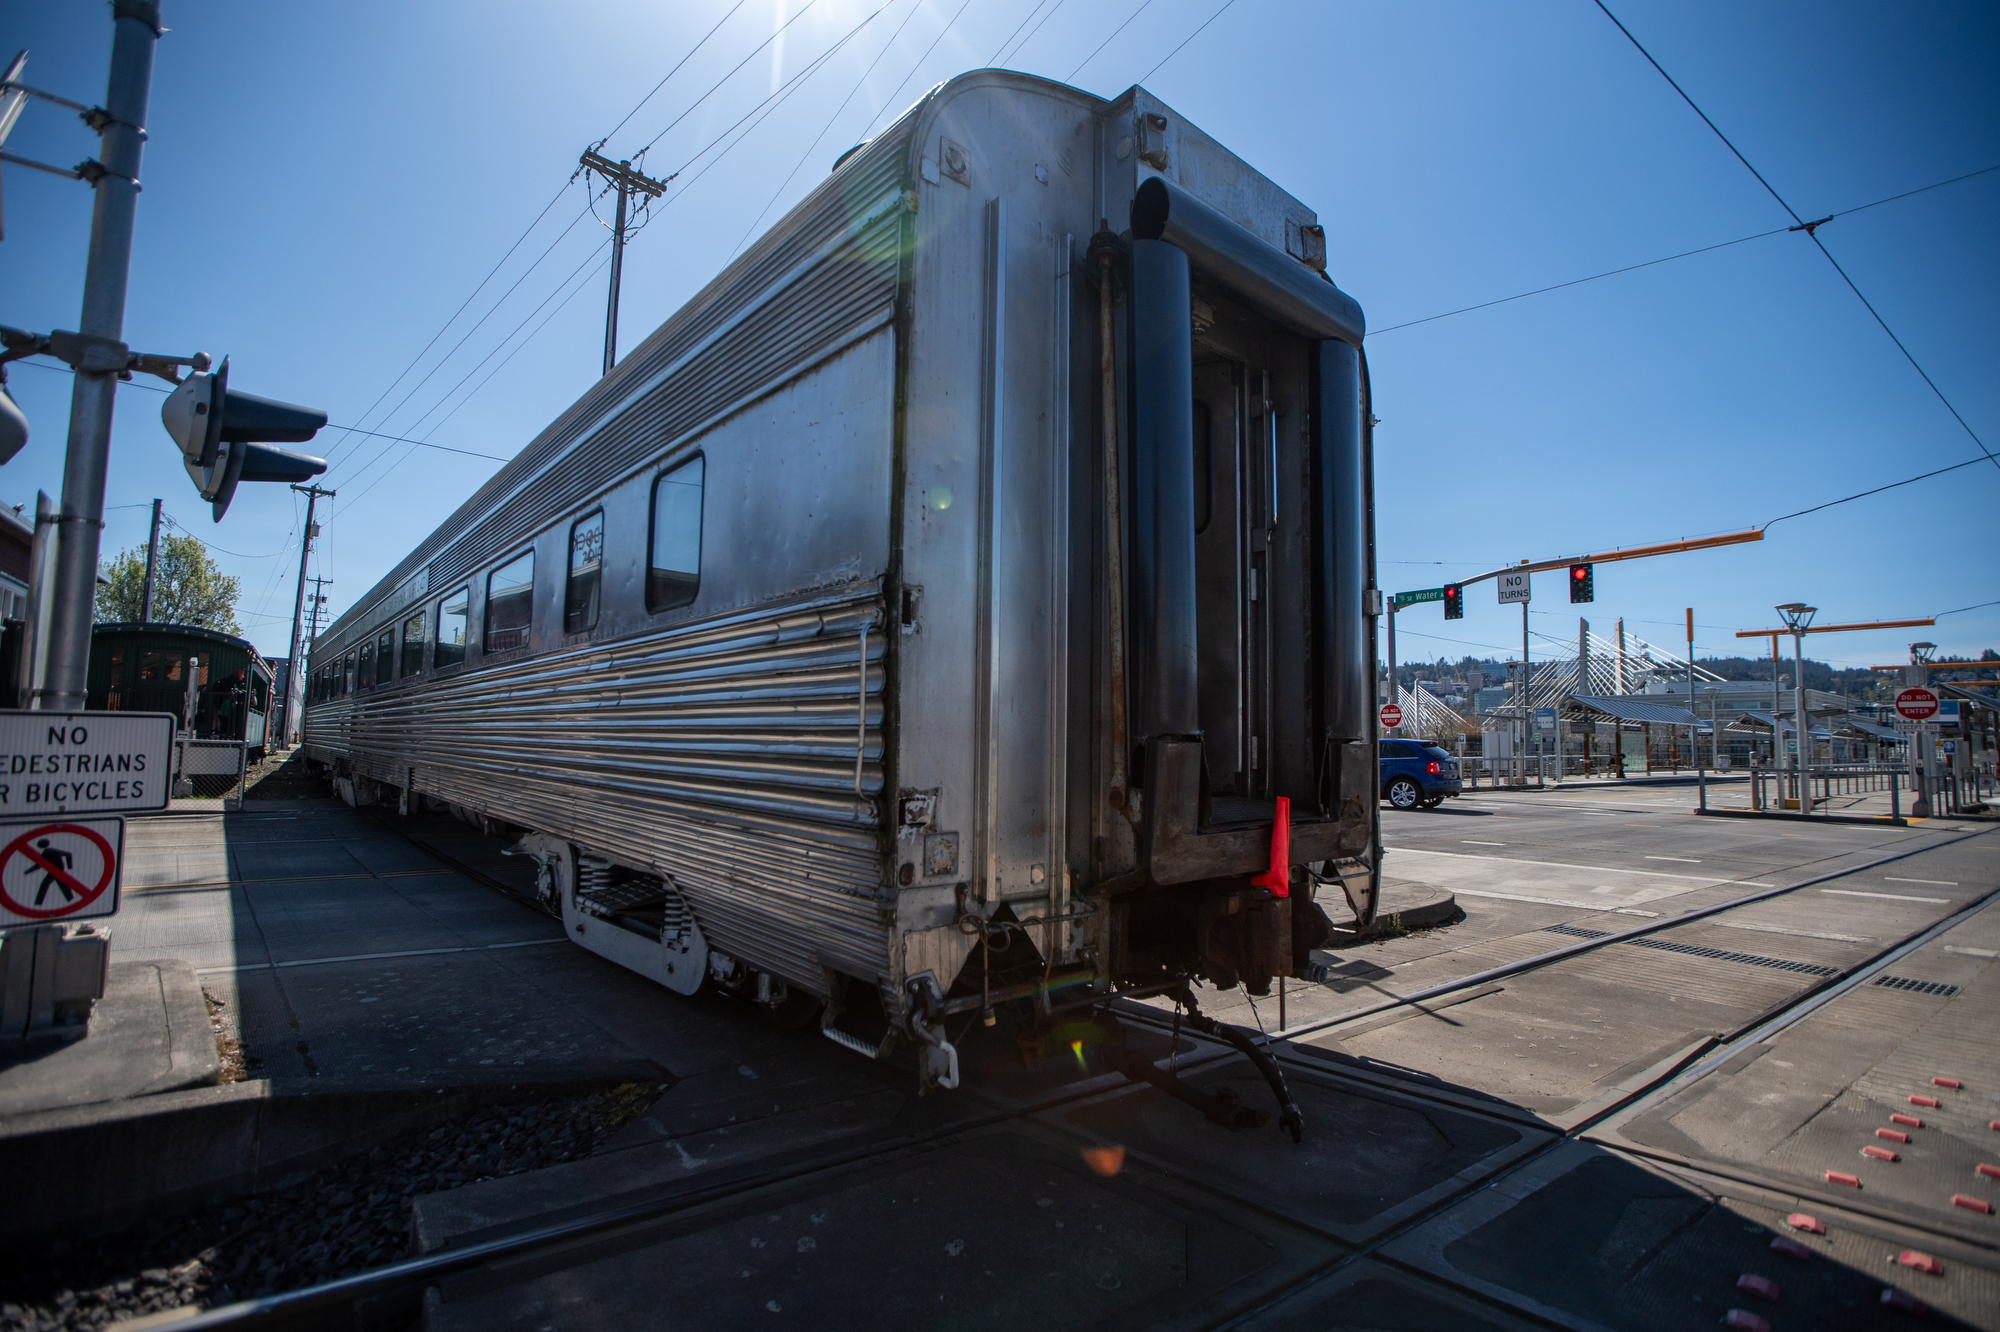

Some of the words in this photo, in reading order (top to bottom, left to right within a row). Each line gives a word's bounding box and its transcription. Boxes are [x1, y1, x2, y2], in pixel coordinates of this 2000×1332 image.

[1506, 576, 1522, 587] NO
[394, 576, 426, 608] PACIFIC
[1415, 591, 1438, 600] Water
[1500, 589, 1529, 600] TURNS
[47, 726, 88, 745] NO
[0, 753, 147, 775] EDESTRIANS
[0, 783, 10, 803] R
[26, 780, 144, 803] BICYCLES
